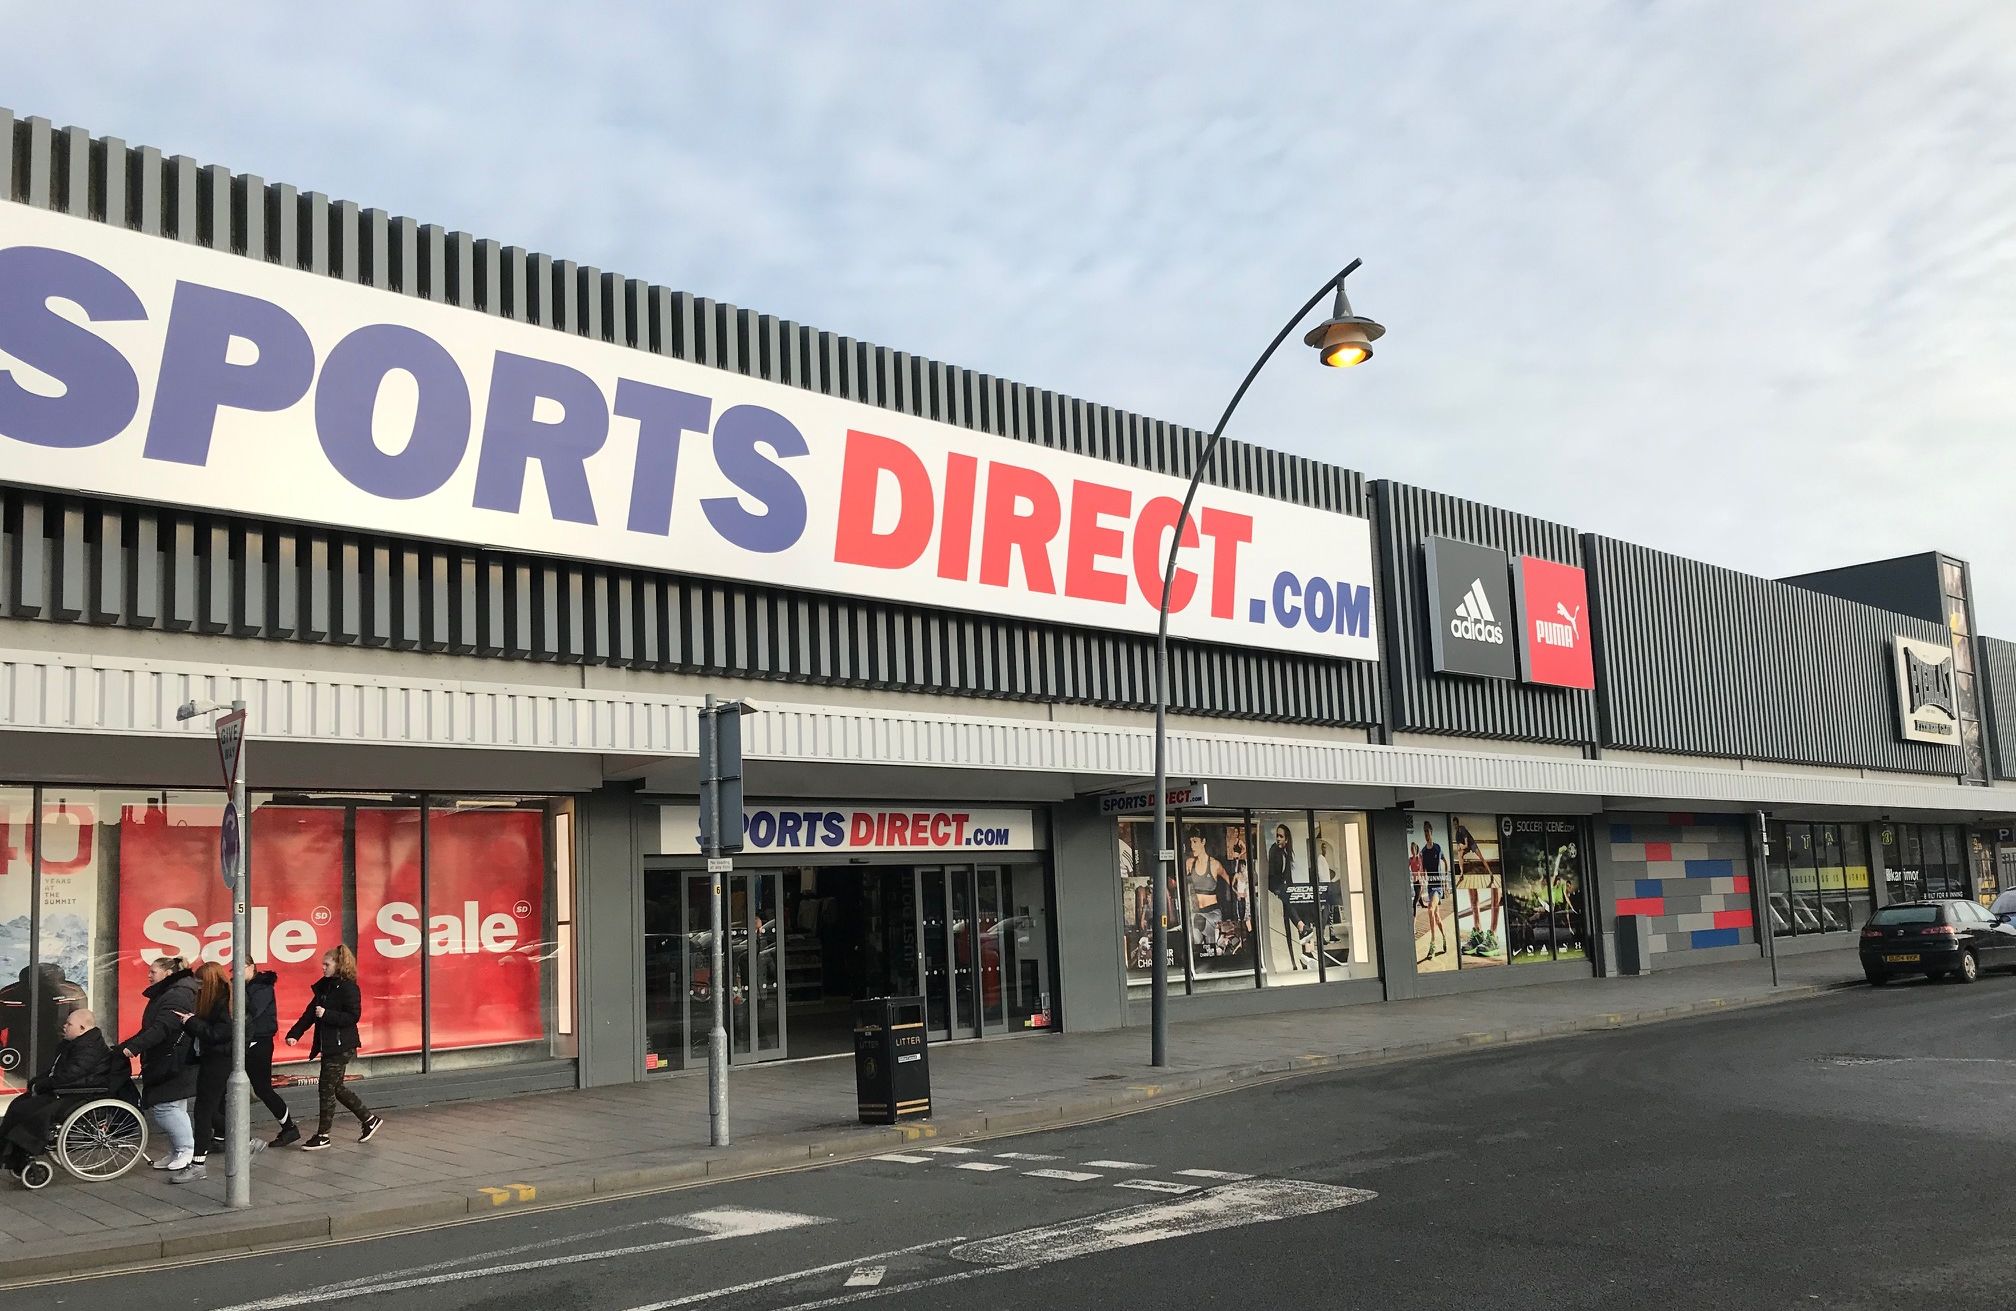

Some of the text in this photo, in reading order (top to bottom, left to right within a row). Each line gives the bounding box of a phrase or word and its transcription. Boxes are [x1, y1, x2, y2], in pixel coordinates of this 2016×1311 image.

[0, 246, 810, 554] SPORTS
[1451, 617, 1504, 645] adidas
[1536, 620, 1574, 648] PUMA
[221, 724, 238, 745] GIVE
[224, 749, 236, 761] WAY
[1103, 795, 1147, 811] SPORTS
[695, 811, 845, 848] ORTS
[1516, 821, 1543, 832] SOCCER
[1891, 868, 1920, 881] karimor
[716, 886, 721, 895] 6
[238, 904, 244, 913] 5
[140, 906, 317, 966] Sale
[374, 900, 519, 959] Sale
[895, 1036, 921, 1047] LITTER
